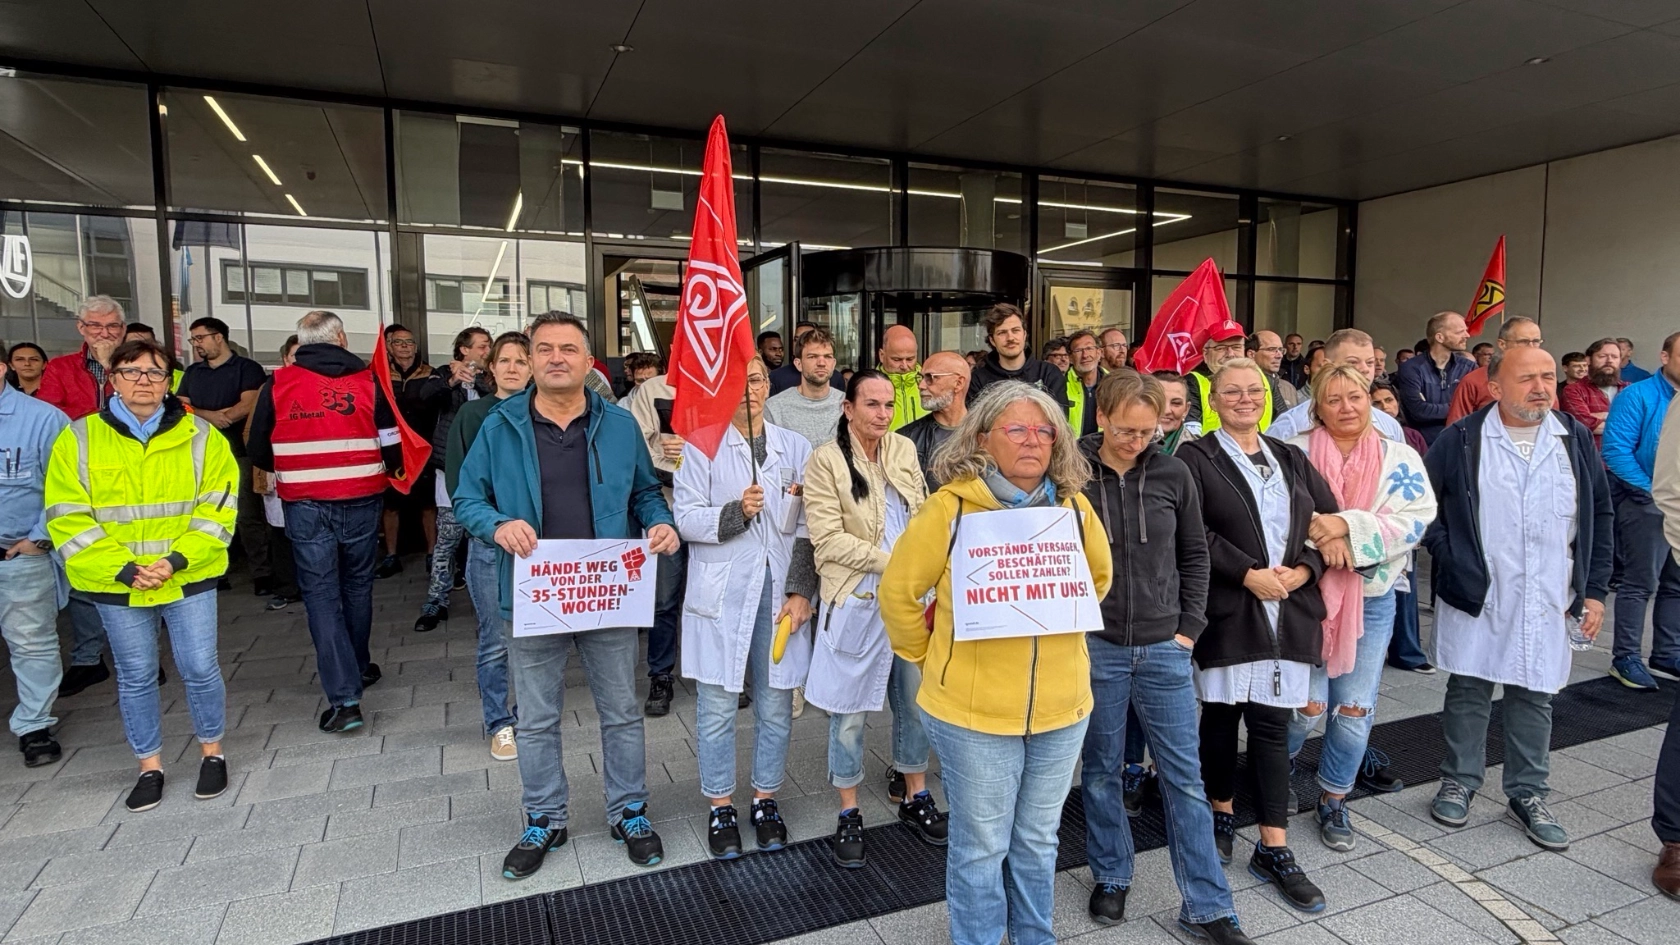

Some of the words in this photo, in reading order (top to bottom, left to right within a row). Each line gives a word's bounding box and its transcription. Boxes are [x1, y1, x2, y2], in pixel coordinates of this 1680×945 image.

[319, 387, 356, 416] 35
[300, 411, 325, 419] Metall
[968, 543, 1034, 558] VORSTÄNDE
[1037, 542, 1080, 553] VERSAGEN,
[531, 561, 582, 577] HÄNDE
[586, 560, 618, 573] WEG
[997, 554, 1071, 569] BESCHÄFTIGTE
[550, 576, 576, 586] VON
[579, 574, 602, 585] DER
[988, 569, 1030, 581] SOLLEN
[1033, 566, 1071, 579] ZAHLEN?
[531, 584, 635, 603] 35-STUNDEN-
[966, 585, 1021, 605] NICHT
[1026, 582, 1056, 600] MIT
[1060, 581, 1088, 598] UNS!
[561, 598, 621, 614] WOCHE!
